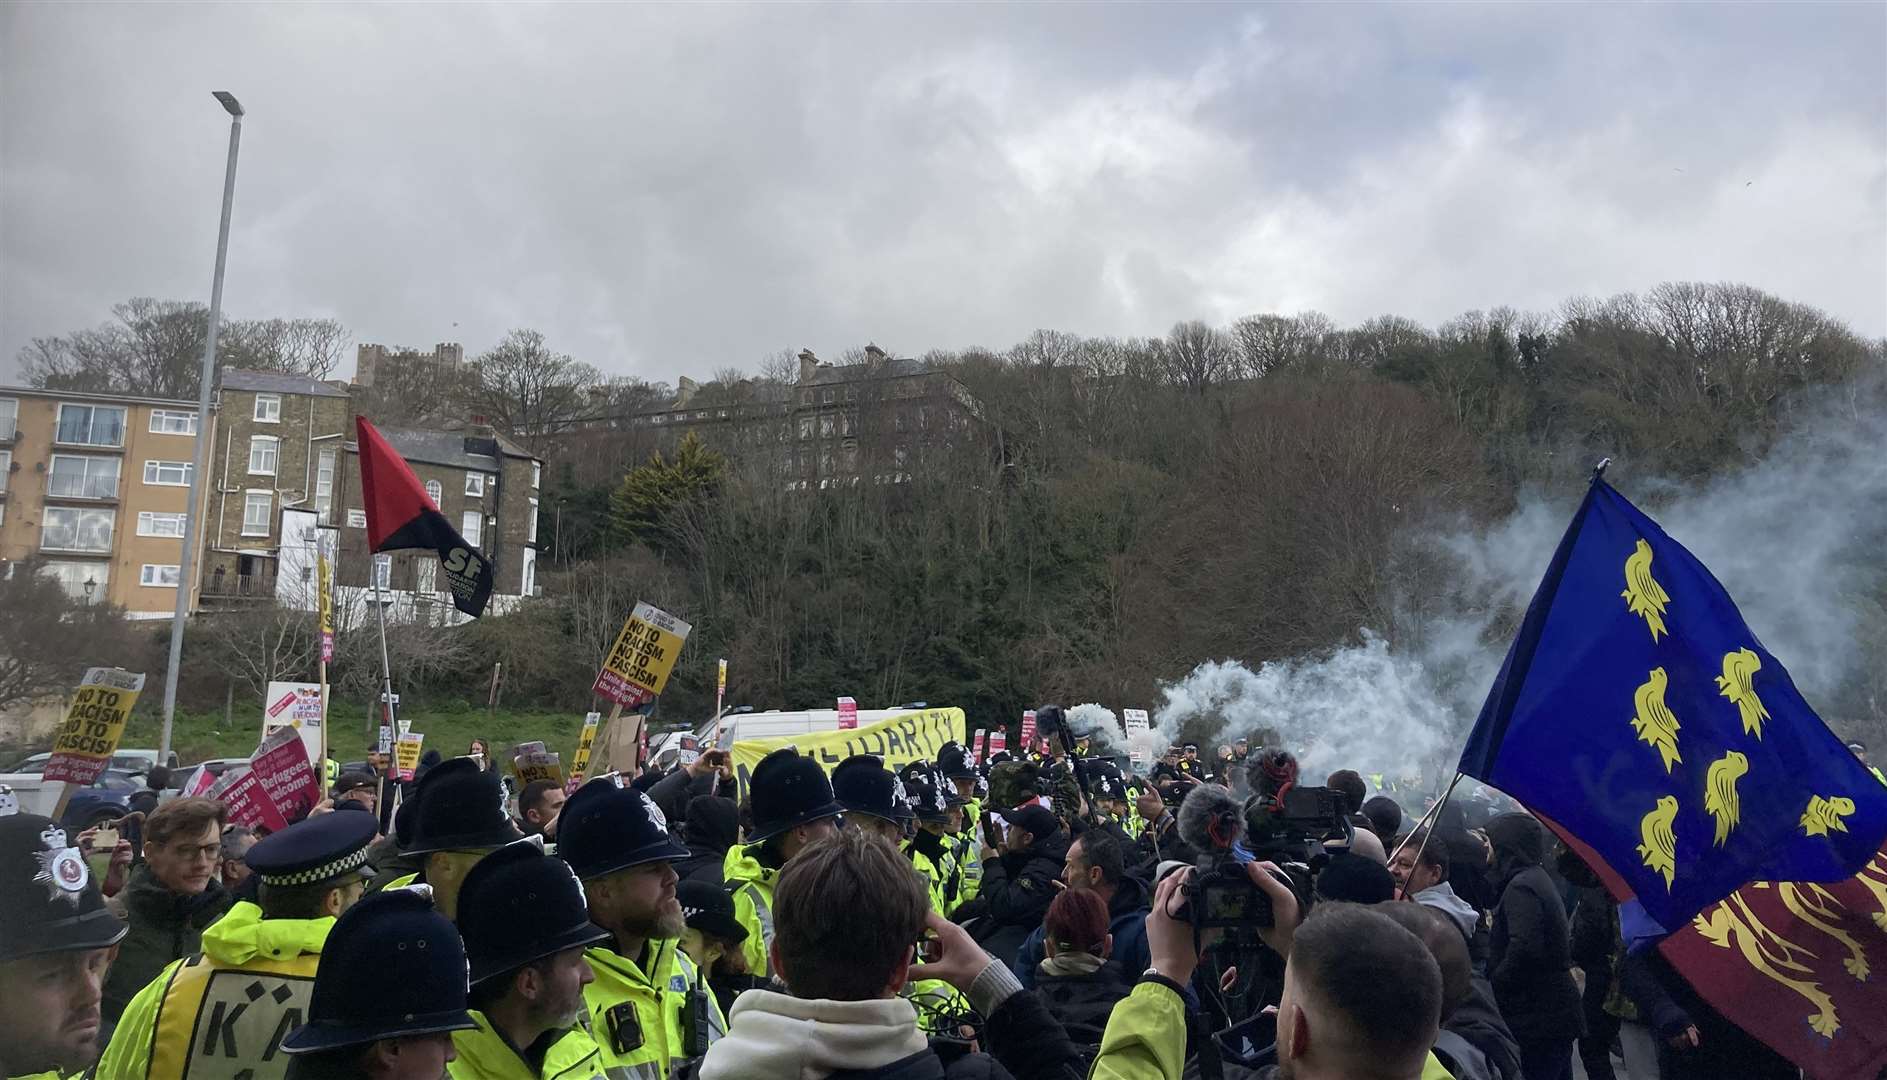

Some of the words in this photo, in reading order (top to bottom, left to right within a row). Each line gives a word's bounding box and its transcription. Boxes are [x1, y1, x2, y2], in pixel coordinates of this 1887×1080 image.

[443, 548, 481, 577] SF
[628, 620, 645, 635] NO
[645, 626, 660, 643] TO
[616, 644, 634, 660] NO
[633, 651, 650, 668] TO
[609, 656, 658, 688] FASCISM
[76, 688, 95, 704] NO
[97, 690, 120, 707] TO
[64, 720, 81, 734] NO
[85, 721, 109, 738] TO
[808, 711, 954, 763] LIDARITY
[260, 759, 309, 789] Refugees
[223, 776, 257, 804] erman
[277, 799, 294, 813] ere
